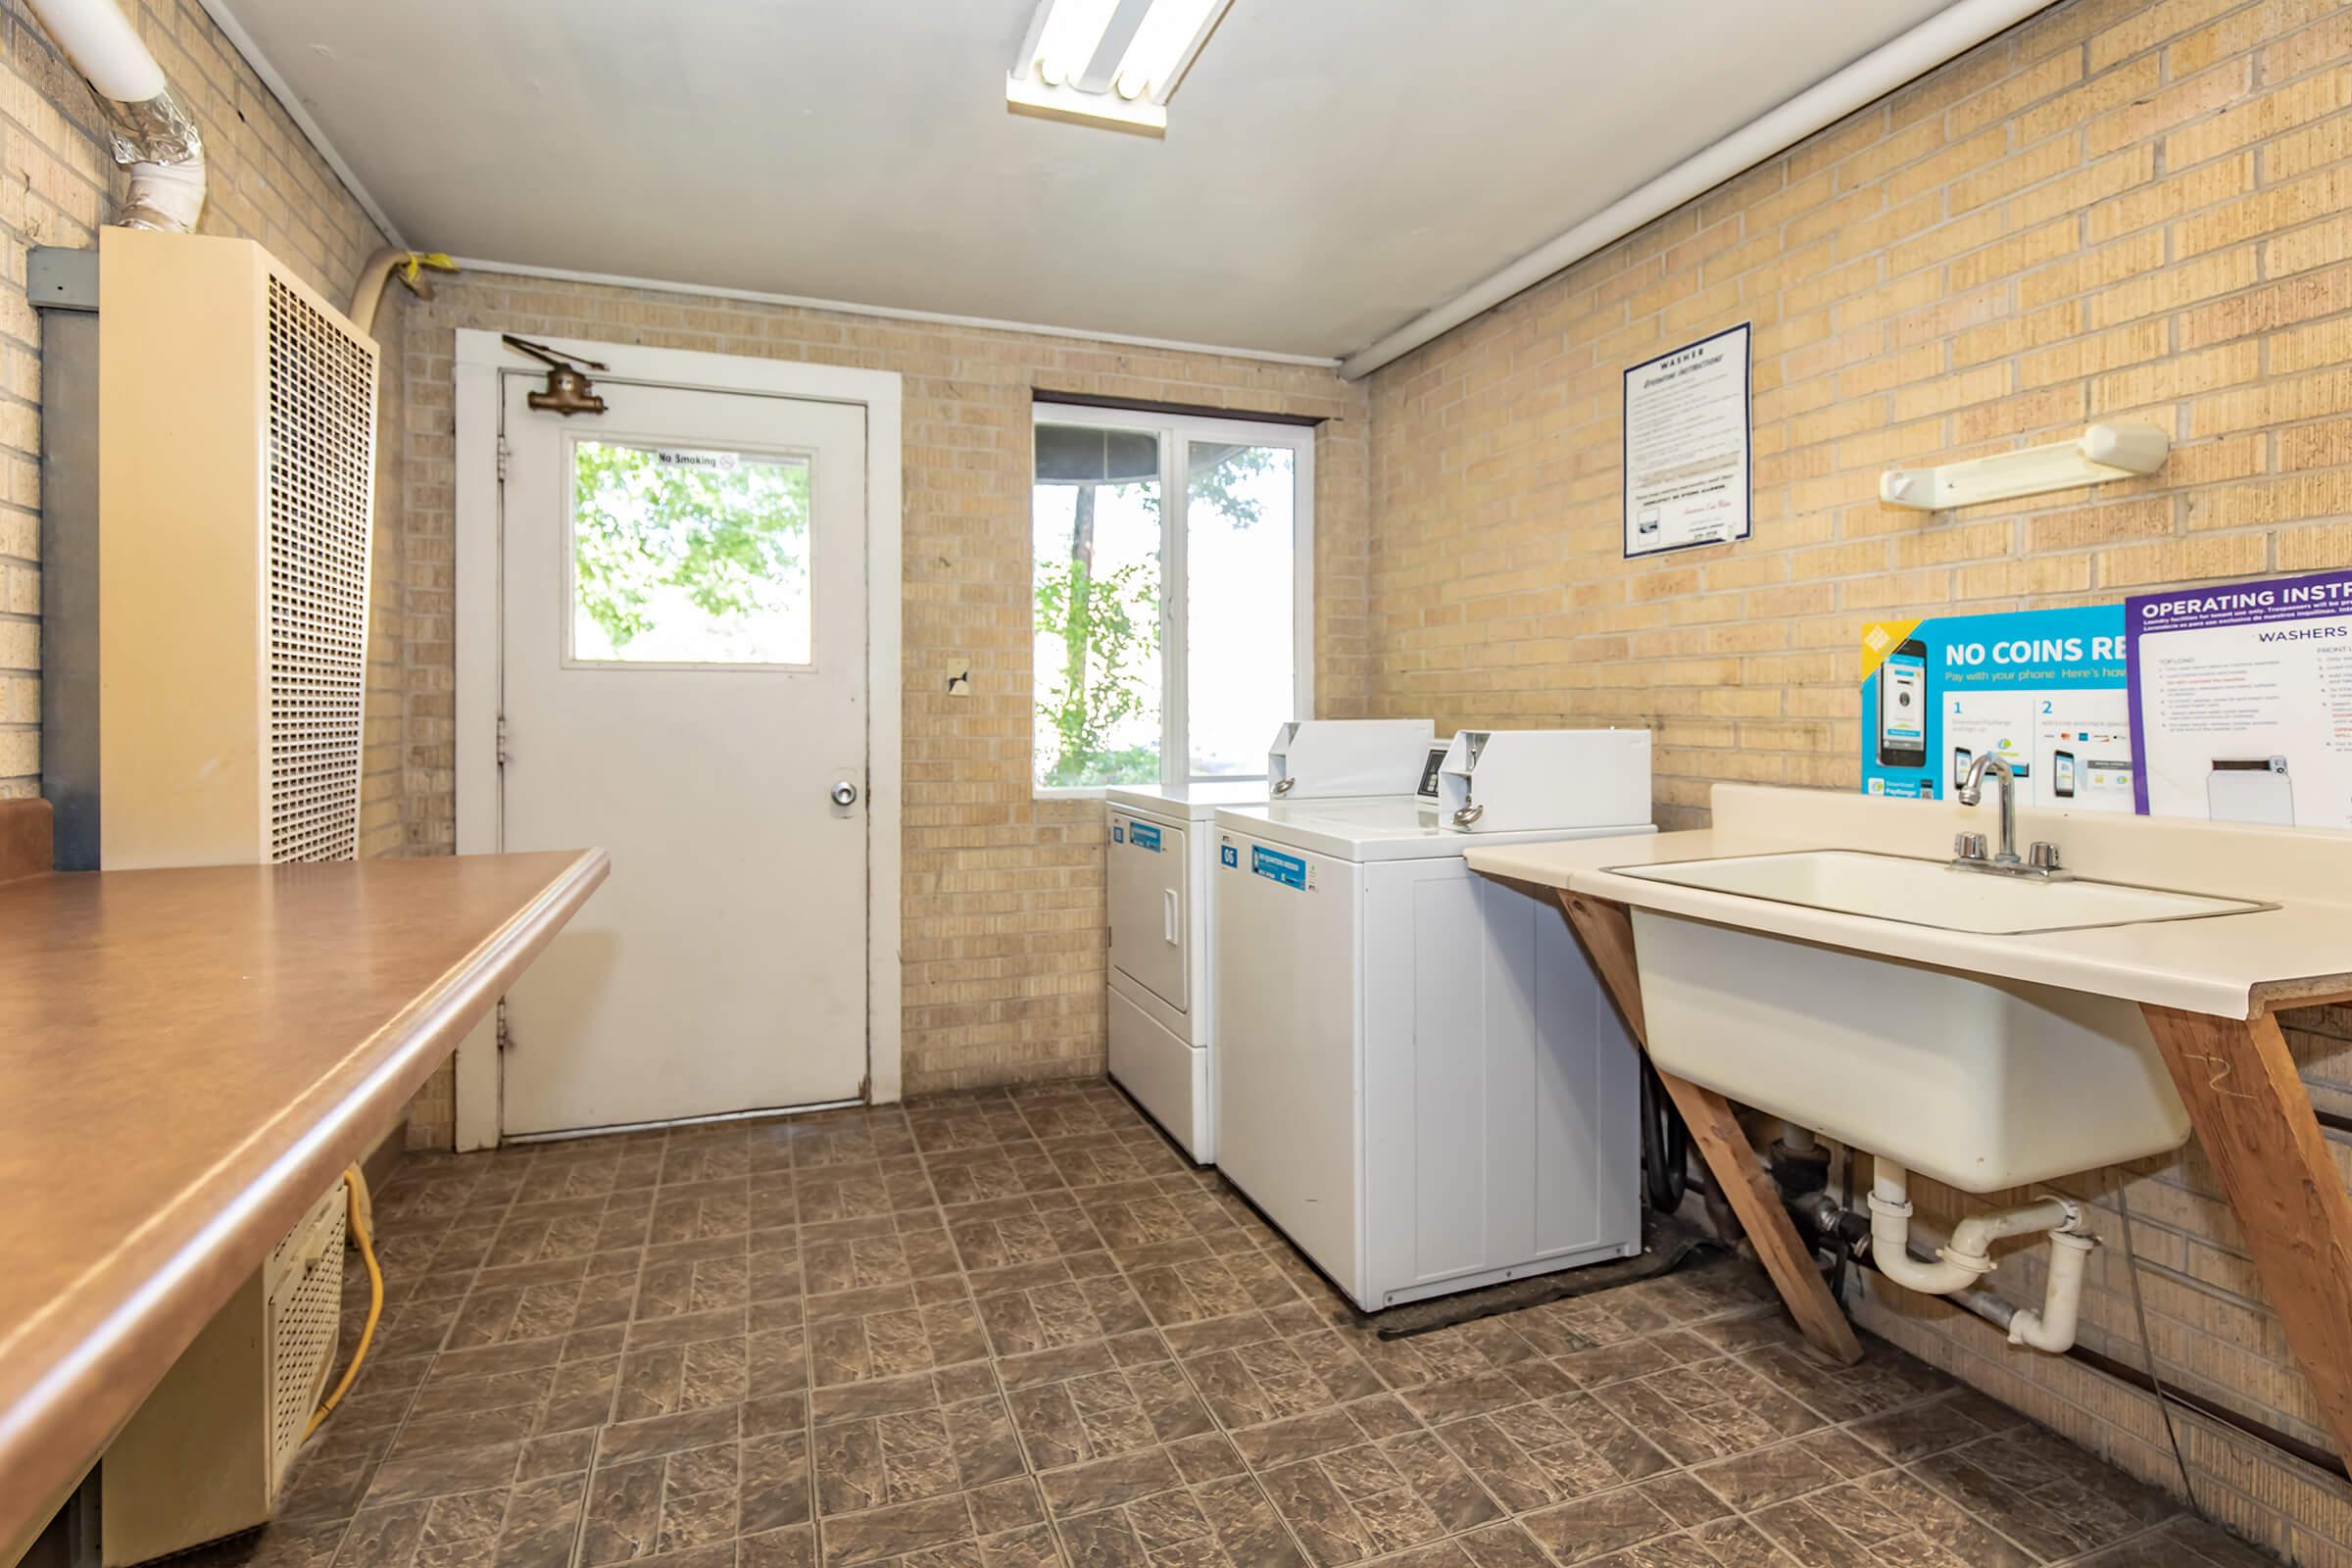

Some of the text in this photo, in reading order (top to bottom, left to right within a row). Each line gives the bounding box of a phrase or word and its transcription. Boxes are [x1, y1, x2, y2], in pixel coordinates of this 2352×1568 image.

[1661, 348, 1704, 369] WASHER
[659, 453, 716, 467] No Smoking
[2141, 590, 2275, 619] OPERATING
[2259, 626, 2348, 643] WASHERS
[1945, 643, 1985, 666] NO
[1992, 637, 2083, 664] COINS
[1945, 671, 1963, 683] Pay
[1966, 670, 1988, 681] with
[1991, 671, 2015, 683] your
[2062, 668, 2099, 679] Here's
[1953, 702, 1962, 714] 1
[2041, 701, 2053, 714] 2
